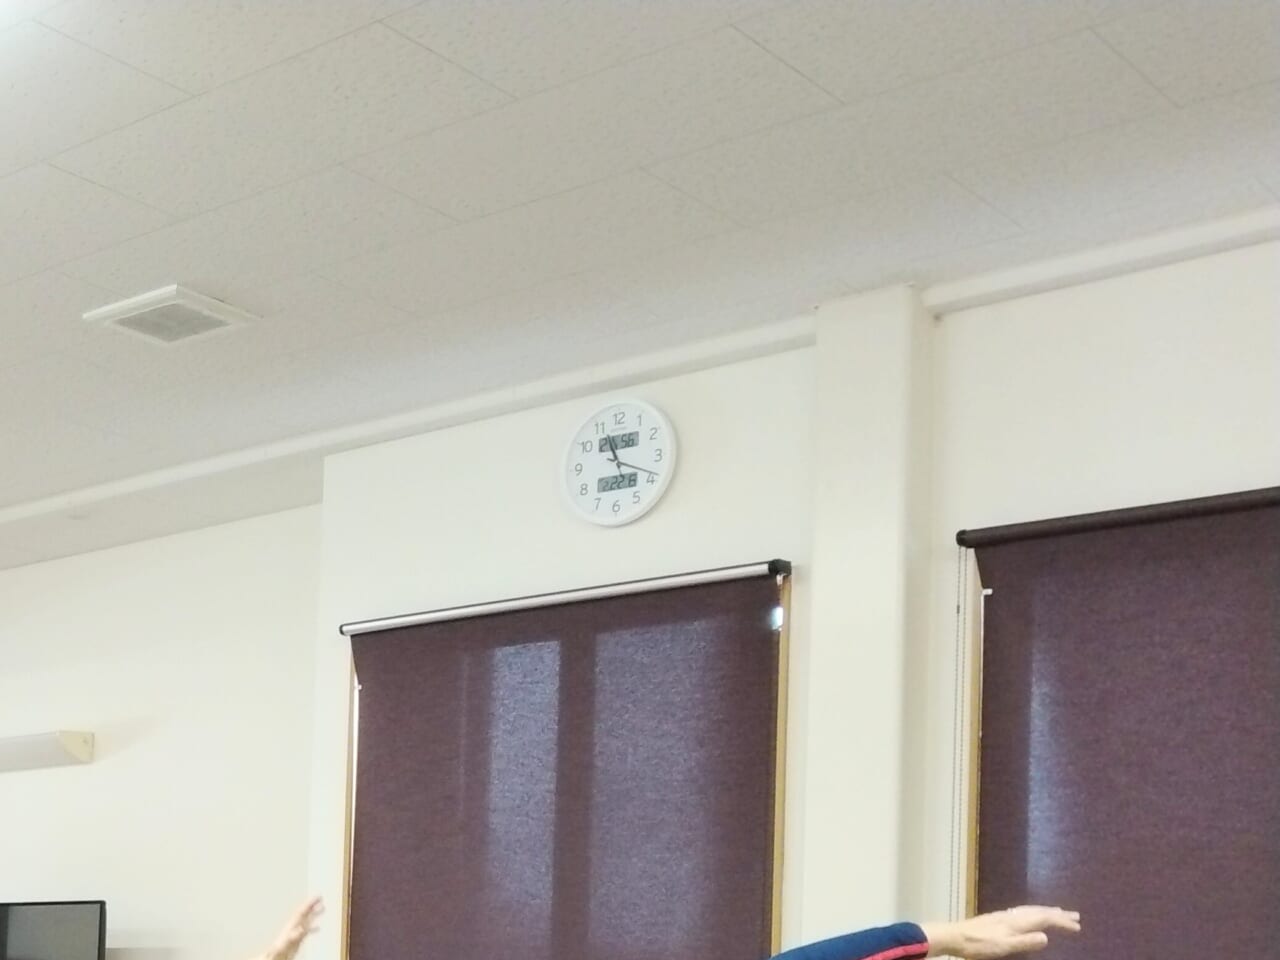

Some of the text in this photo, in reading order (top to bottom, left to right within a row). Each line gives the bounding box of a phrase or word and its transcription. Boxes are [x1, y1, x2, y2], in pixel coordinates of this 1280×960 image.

[613, 411, 625, 426] 12
[594, 422, 606, 435] 11
[649, 427, 658, 441] 2
[581, 440, 593, 454] 10
[654, 448, 663, 463] 3
[574, 463, 583, 476] 9
[646, 474, 656, 486] 4
[579, 483, 589, 496] 8
[594, 497, 602, 511] 7
[632, 490, 641, 504] 5
[612, 499, 621, 513] 6
